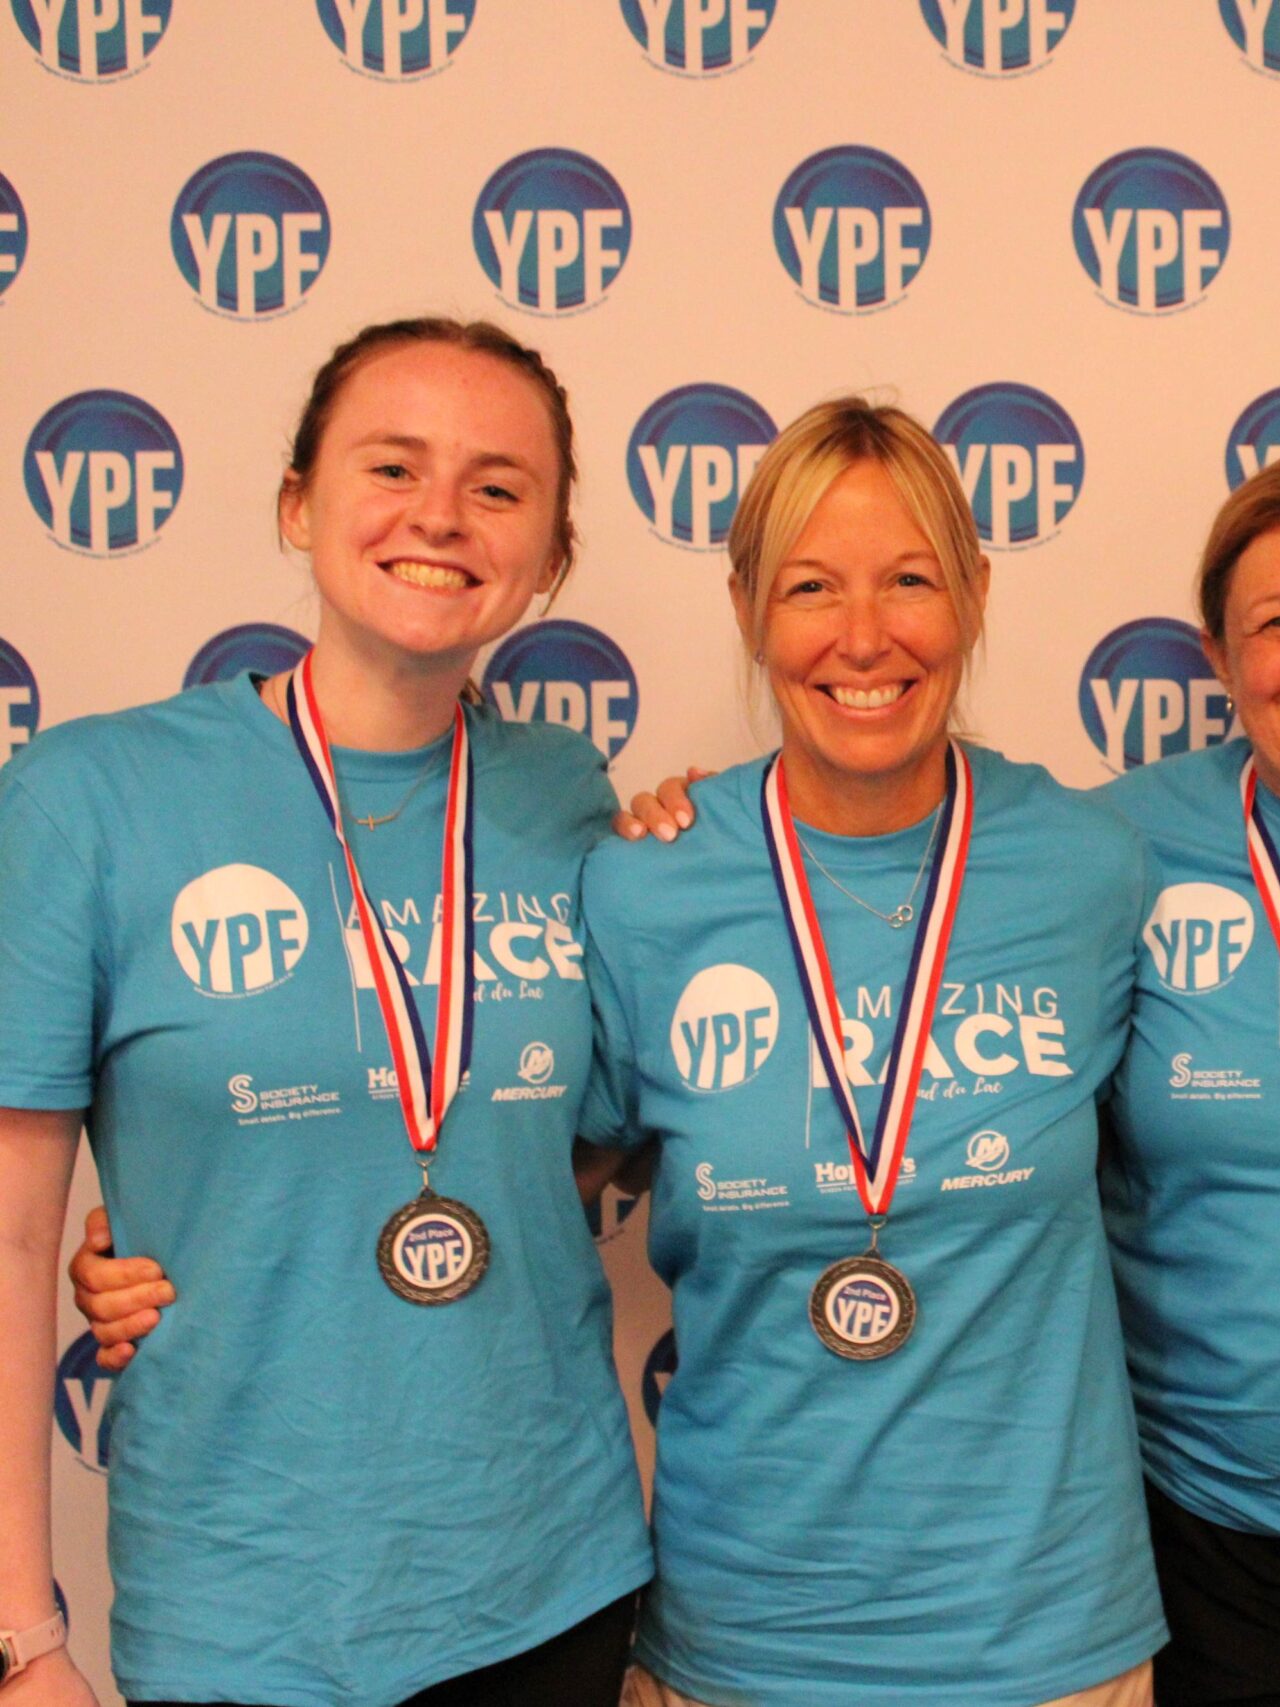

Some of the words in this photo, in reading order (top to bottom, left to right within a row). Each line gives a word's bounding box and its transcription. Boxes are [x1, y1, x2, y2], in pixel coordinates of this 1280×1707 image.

[29, 0, 162, 76] YPF
[333, 0, 466, 75] YPF
[637, 0, 767, 72] YPF
[935, 0, 1066, 71] YPF
[182, 213, 322, 315] YPF
[484, 209, 623, 311] YPF
[785, 207, 923, 308] YPF
[1083, 209, 1222, 310] YPF
[35, 451, 174, 550] YPF
[181, 909, 300, 993] YPF
[1151, 917, 1246, 991] YPF
[680, 1006, 771, 1090] YPF
[491, 1085, 568, 1102] MERCURY
[940, 1167, 1035, 1192] MERCURY
[404, 1239, 462, 1281] YPF
[837, 1297, 891, 1339] YPF
